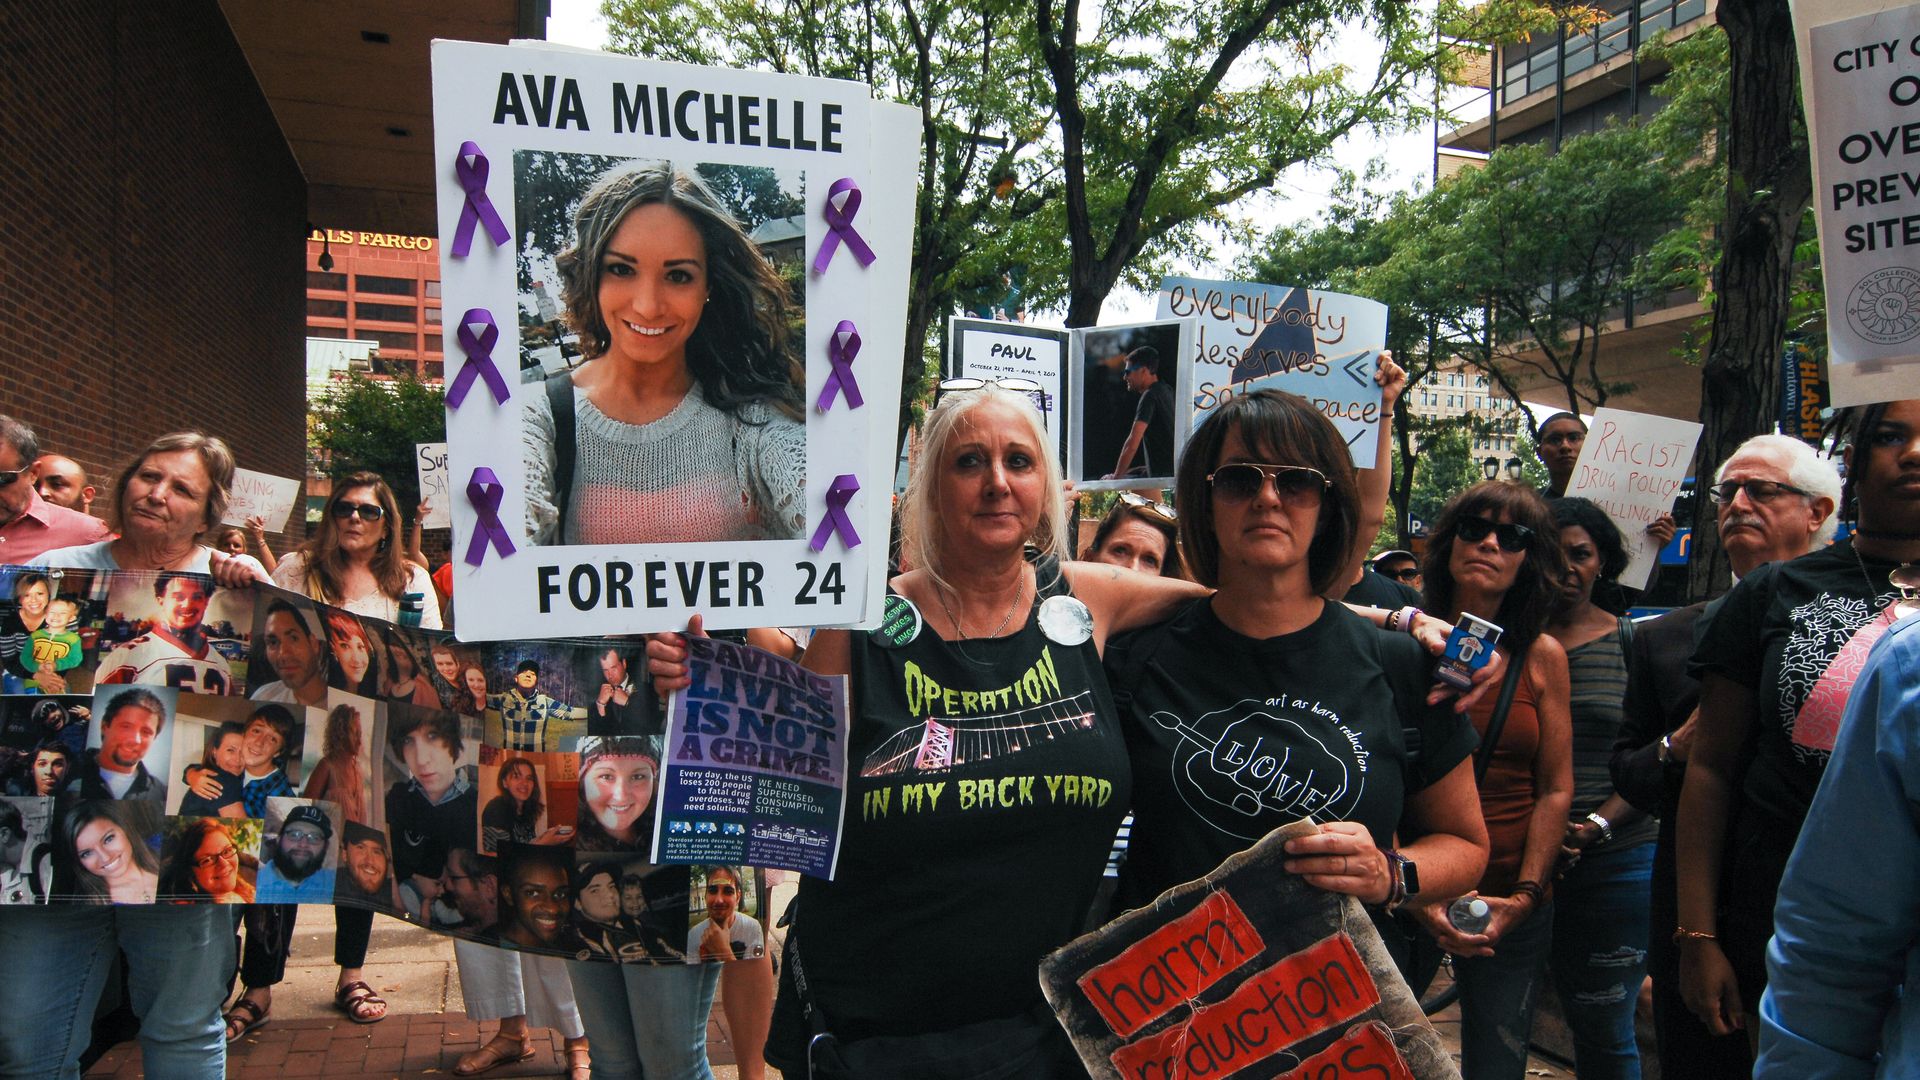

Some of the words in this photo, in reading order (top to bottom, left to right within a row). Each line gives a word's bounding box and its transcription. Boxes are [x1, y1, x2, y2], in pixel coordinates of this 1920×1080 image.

[1833, 39, 1899, 73] CITY
[493, 72, 590, 131] AVA
[612, 82, 842, 153] MICHELLE
[358, 231, 433, 251] FARGO
[1170, 285, 1345, 345] everybody
[969, 363, 992, 371] OCTOBER
[991, 343, 1036, 361] PAUL
[1195, 325, 1331, 379] deserves
[1303, 395, 1379, 424] pace
[1799, 345, 1822, 438] HLASH
[1594, 421, 1687, 467] RACIST
[232, 473, 275, 499] AVING
[1577, 465, 1616, 493] DRUG
[1629, 471, 1680, 502] POLICY
[537, 561, 764, 613] FOREVER
[794, 561, 846, 605] 24
[690, 639, 833, 697] SAVING
[904, 645, 1062, 717] OPERATION
[687, 660, 836, 729] LIVES
[683, 701, 730, 736] IS
[736, 708, 836, 759] NOT
[1265, 693, 1288, 708] art
[1292, 699, 1309, 709] as
[1311, 701, 1340, 724] harm
[1339, 725, 1370, 772] reduction
[677, 735, 704, 761] A
[710, 737, 836, 783] CRIME.
[679, 769, 703, 779] Every
[705, 771, 723, 780] day,
[741, 775, 753, 783] US
[1222, 740, 1327, 812] LOVE
[680, 778, 703, 786] loses
[704, 779, 720, 787] 200
[722, 781, 752, 791] people
[688, 795, 735, 805] overdoses.
[737, 798, 750, 806] We
[697, 787, 707, 795] to
[709, 787, 729, 796] fatal
[731, 789, 751, 800] drug
[757, 787, 814, 804] SUPERVISED
[758, 778, 772, 788] WE
[775, 781, 800, 792] NEED
[863, 786, 892, 823] IN
[902, 781, 946, 814] MY
[958, 776, 1035, 811] BACK
[1044, 774, 1113, 809] YARD
[684, 803, 705, 811] need
[706, 804, 749, 814] solutions.
[755, 805, 783, 816] SITES.
[756, 796, 824, 815] CONSUMPTION
[1092, 918, 1244, 1027] harm
